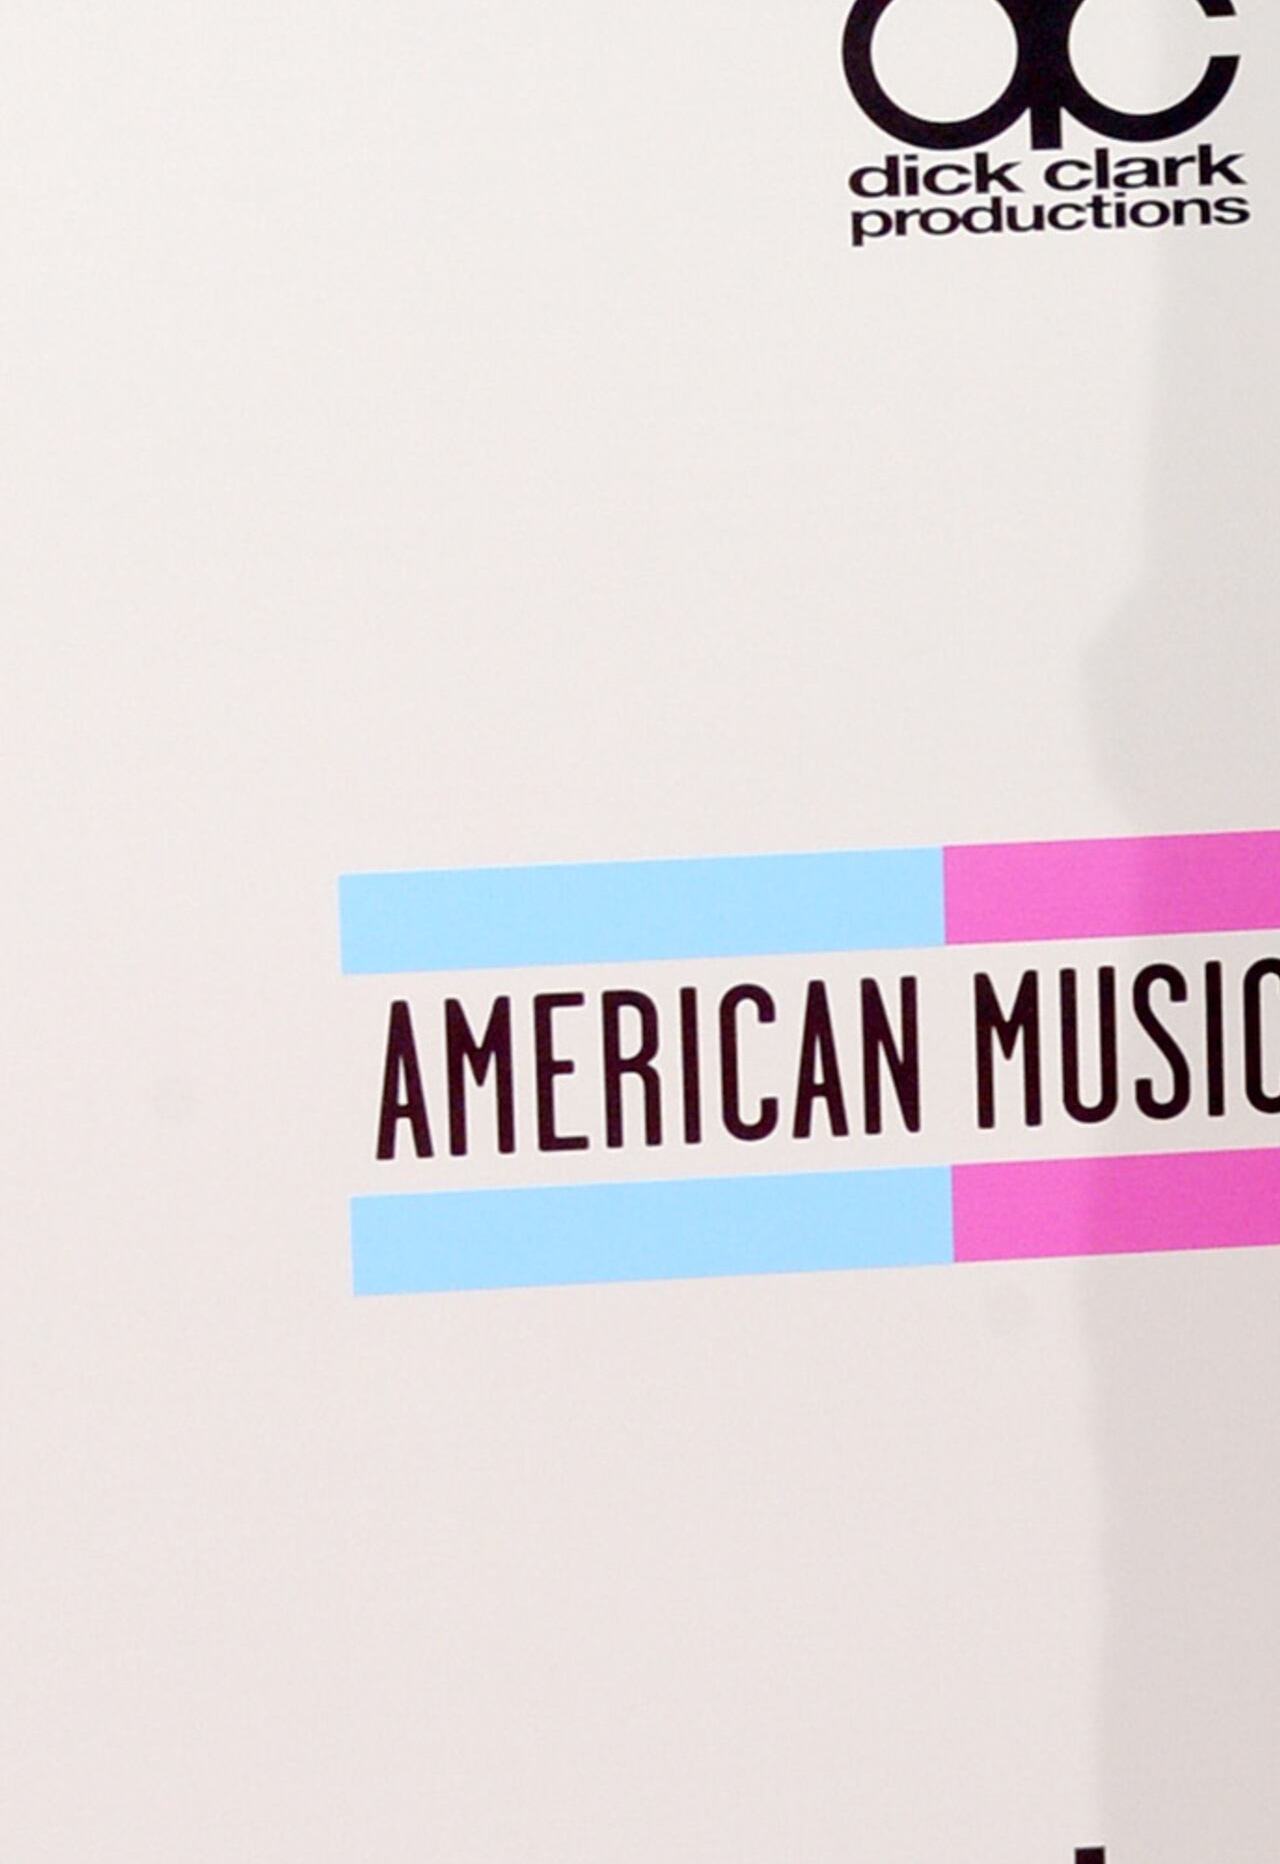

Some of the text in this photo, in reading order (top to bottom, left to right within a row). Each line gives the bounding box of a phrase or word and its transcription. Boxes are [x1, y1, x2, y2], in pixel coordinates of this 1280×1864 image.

[847, 142, 1248, 199] dick clark
[850, 192, 1252, 248] productions
[375, 974, 922, 1161] AMERICAN
